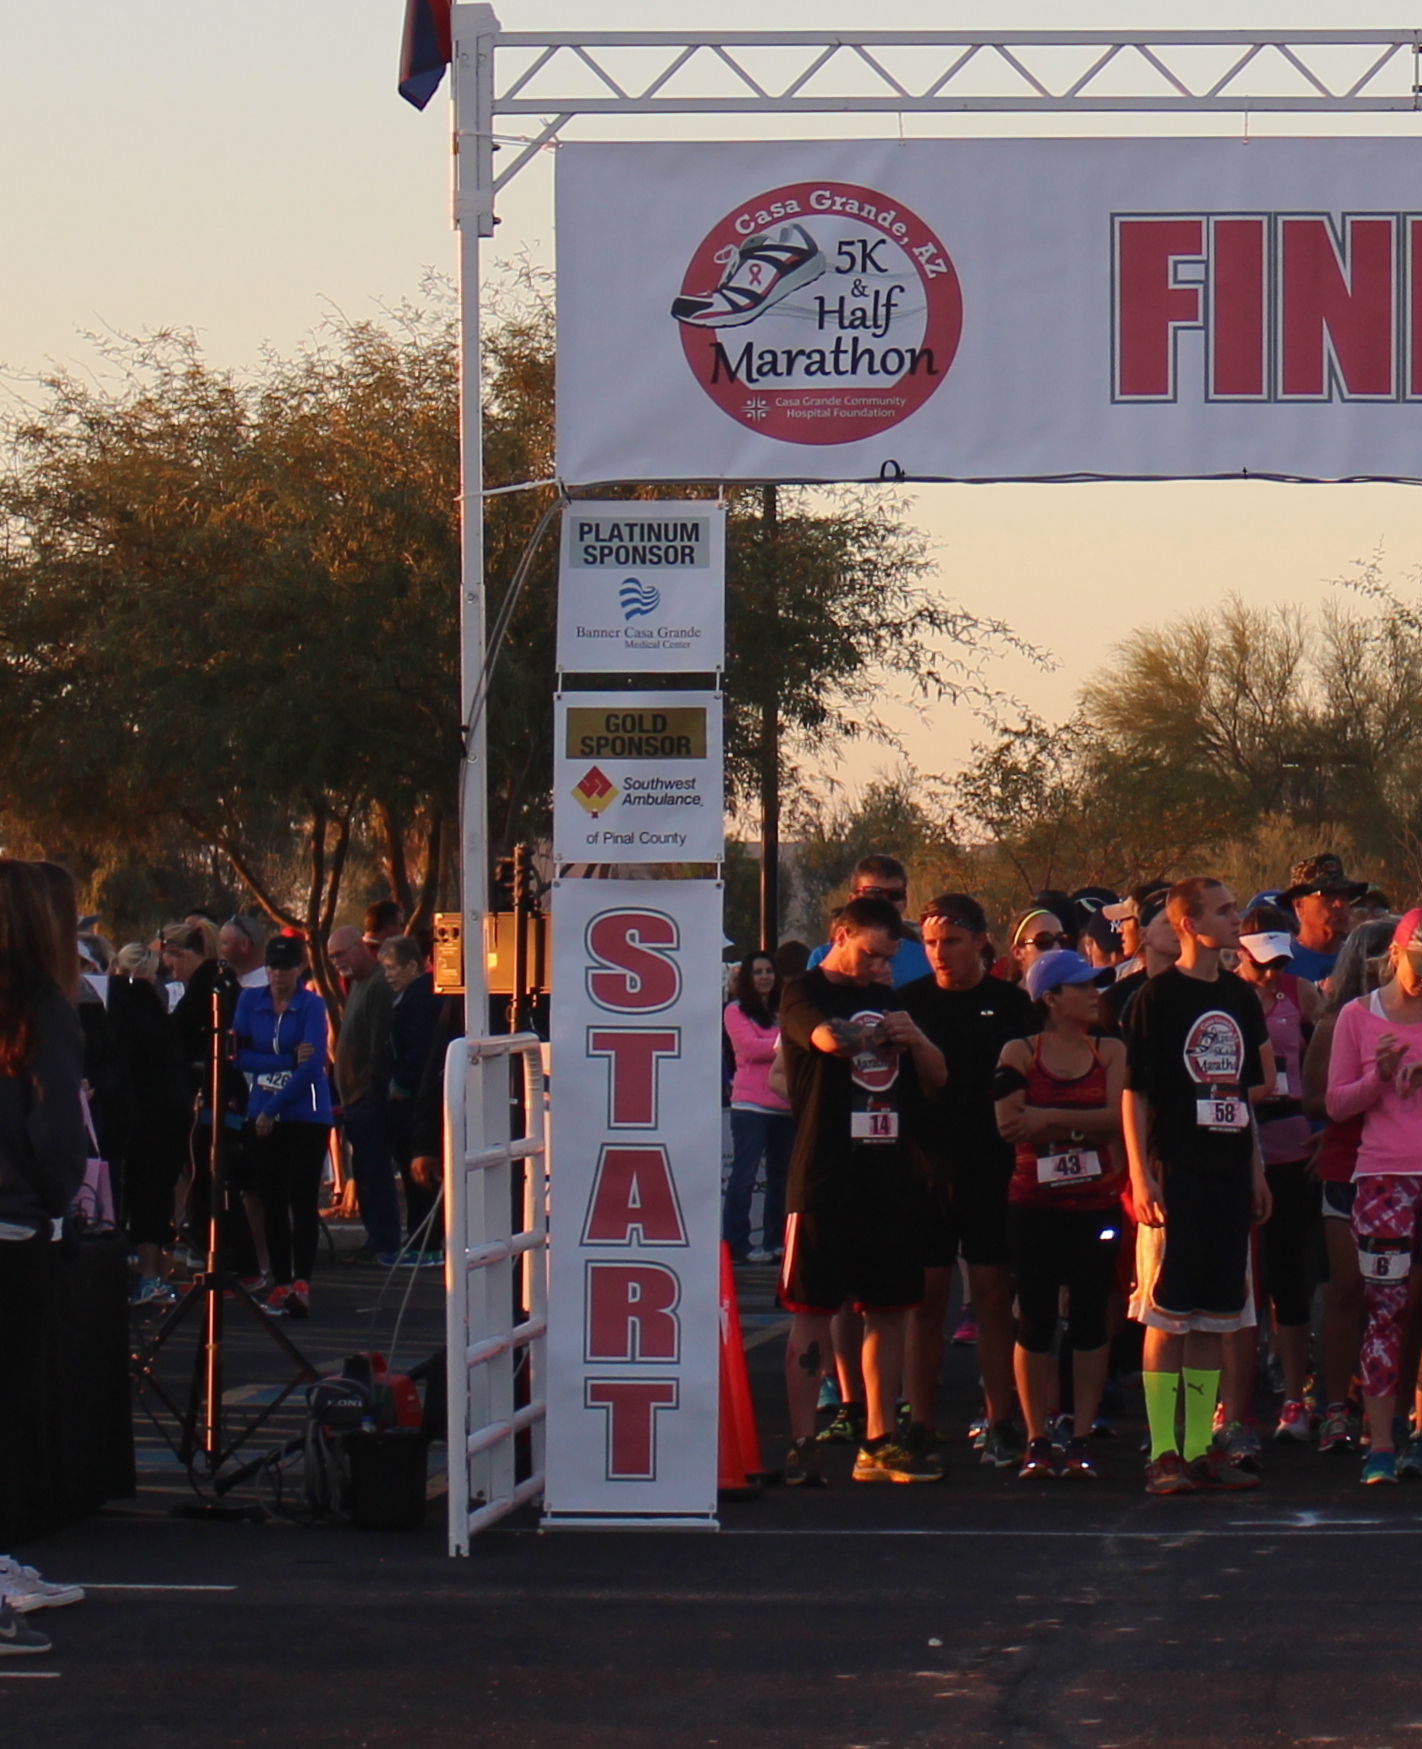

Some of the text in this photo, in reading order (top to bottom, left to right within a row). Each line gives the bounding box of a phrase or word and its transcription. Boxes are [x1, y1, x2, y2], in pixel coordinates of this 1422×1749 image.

[734, 189, 948, 280] Casa Grande, AZ
[834, 238, 889, 275] 5K
[850, 278, 869, 298] &
[814, 284, 905, 339] Half
[708, 335, 939, 385] Marathon
[775, 395, 907, 408] Casa Grande Community
[786, 406, 896, 420] Hospital Foundation
[578, 522, 700, 543] PLATINUM
[583, 544, 696, 566] SPONSOR
[576, 625, 702, 639] Banner Casa Grande
[624, 639, 691, 649] Medical Center
[605, 713, 668, 734] GOLD
[580, 735, 692, 756] SPONSOR
[622, 776, 697, 791] Southwest
[622, 792, 702, 807] Ambulance
[586, 831, 687, 847] of Pinal County
[1215, 1103, 1235, 1122] 58
[869, 1114, 890, 1136] 14
[1056, 1154, 1081, 1176] 43
[579, 906, 690, 1483] START
[1377, 1257, 1389, 1277] 6
